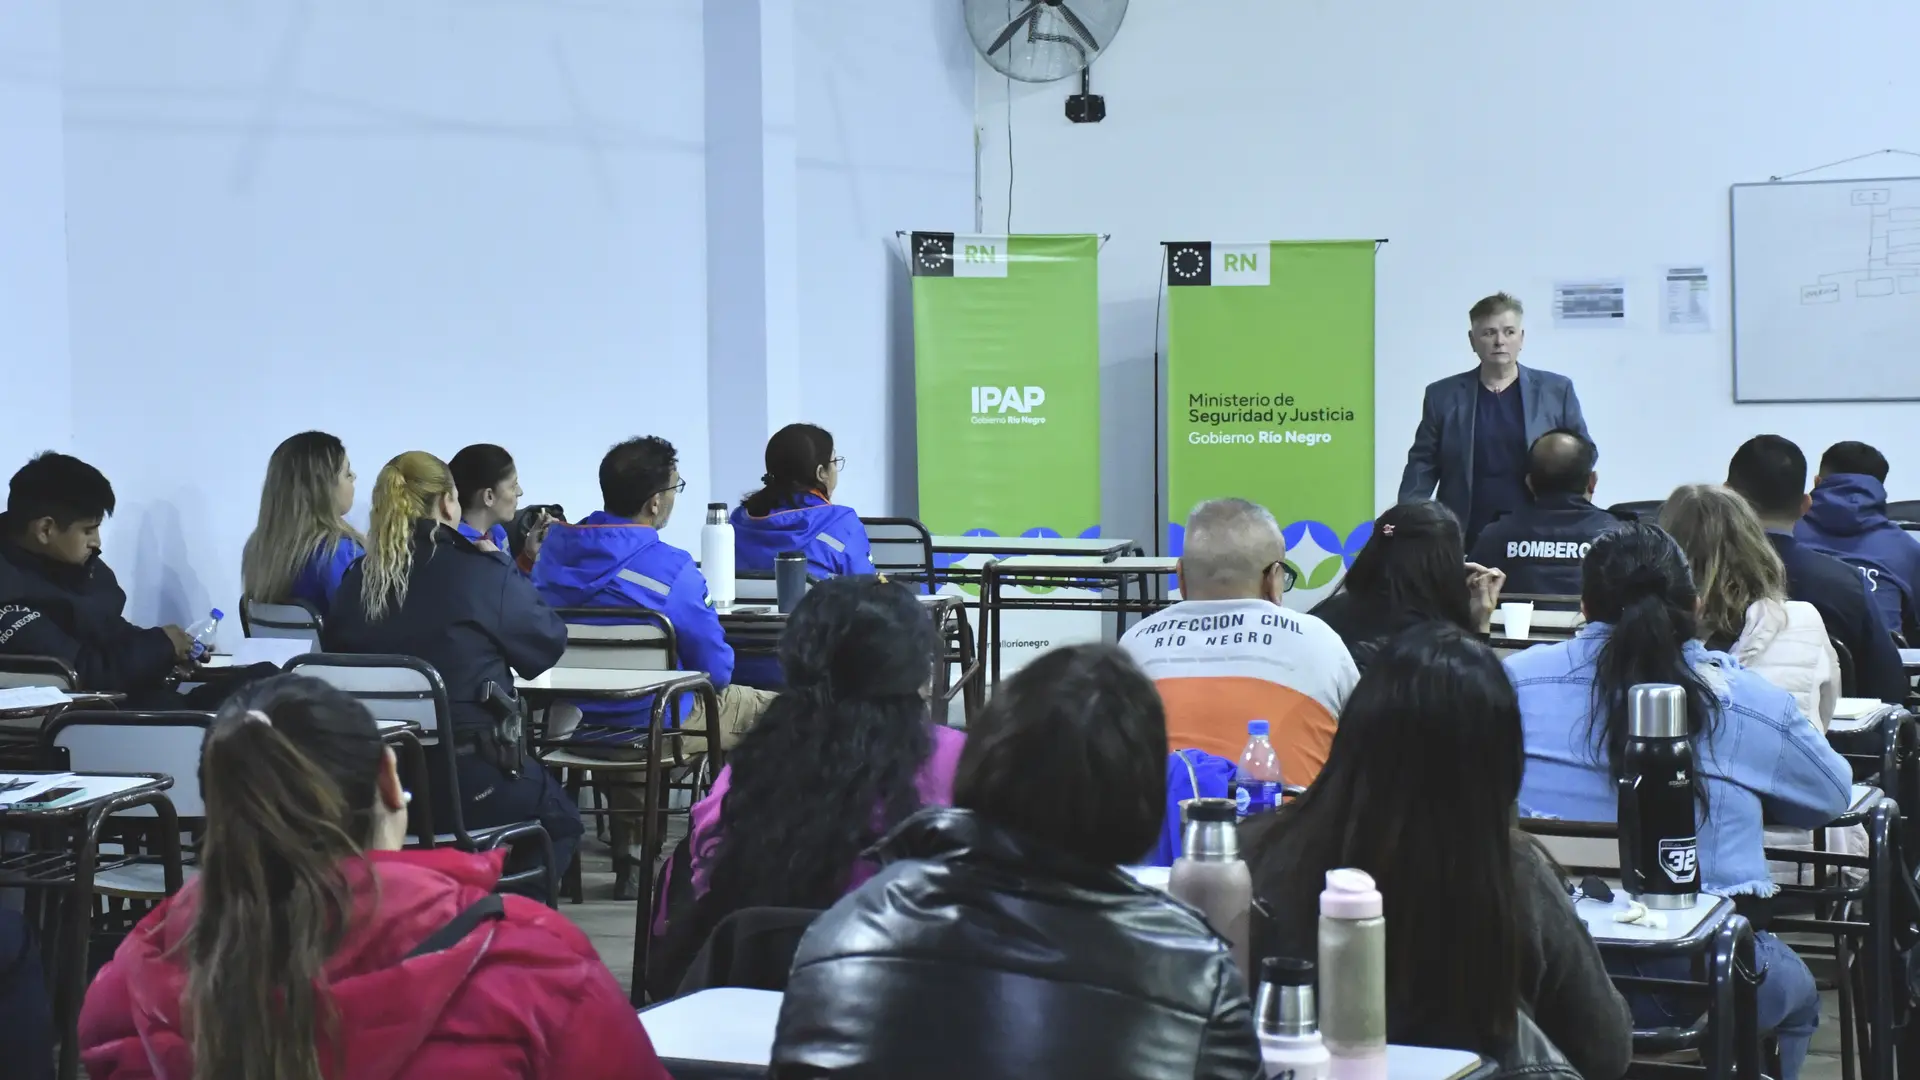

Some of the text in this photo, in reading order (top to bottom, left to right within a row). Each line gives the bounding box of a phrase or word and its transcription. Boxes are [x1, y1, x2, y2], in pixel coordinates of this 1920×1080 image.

[964, 244, 996, 264] RN
[1224, 253, 1257, 272] RN
[971, 386, 1046, 414] IPAP
[1189, 393, 1295, 407] Ministerio de
[971, 416, 1006, 424] Gobierno
[1021, 415, 1046, 426] Negro
[1189, 407, 1354, 426] Seguridad y Justicia
[1188, 431, 1332, 446] Gobierno Río Negro
[1506, 541, 1591, 559] BOMBERO
[11, 611, 41, 631] NEGRO
[1135, 614, 1304, 638] PROTECCION CIVIL
[1154, 631, 1273, 648] RÍO NEGRO
[1668, 849, 1696, 872] 32
